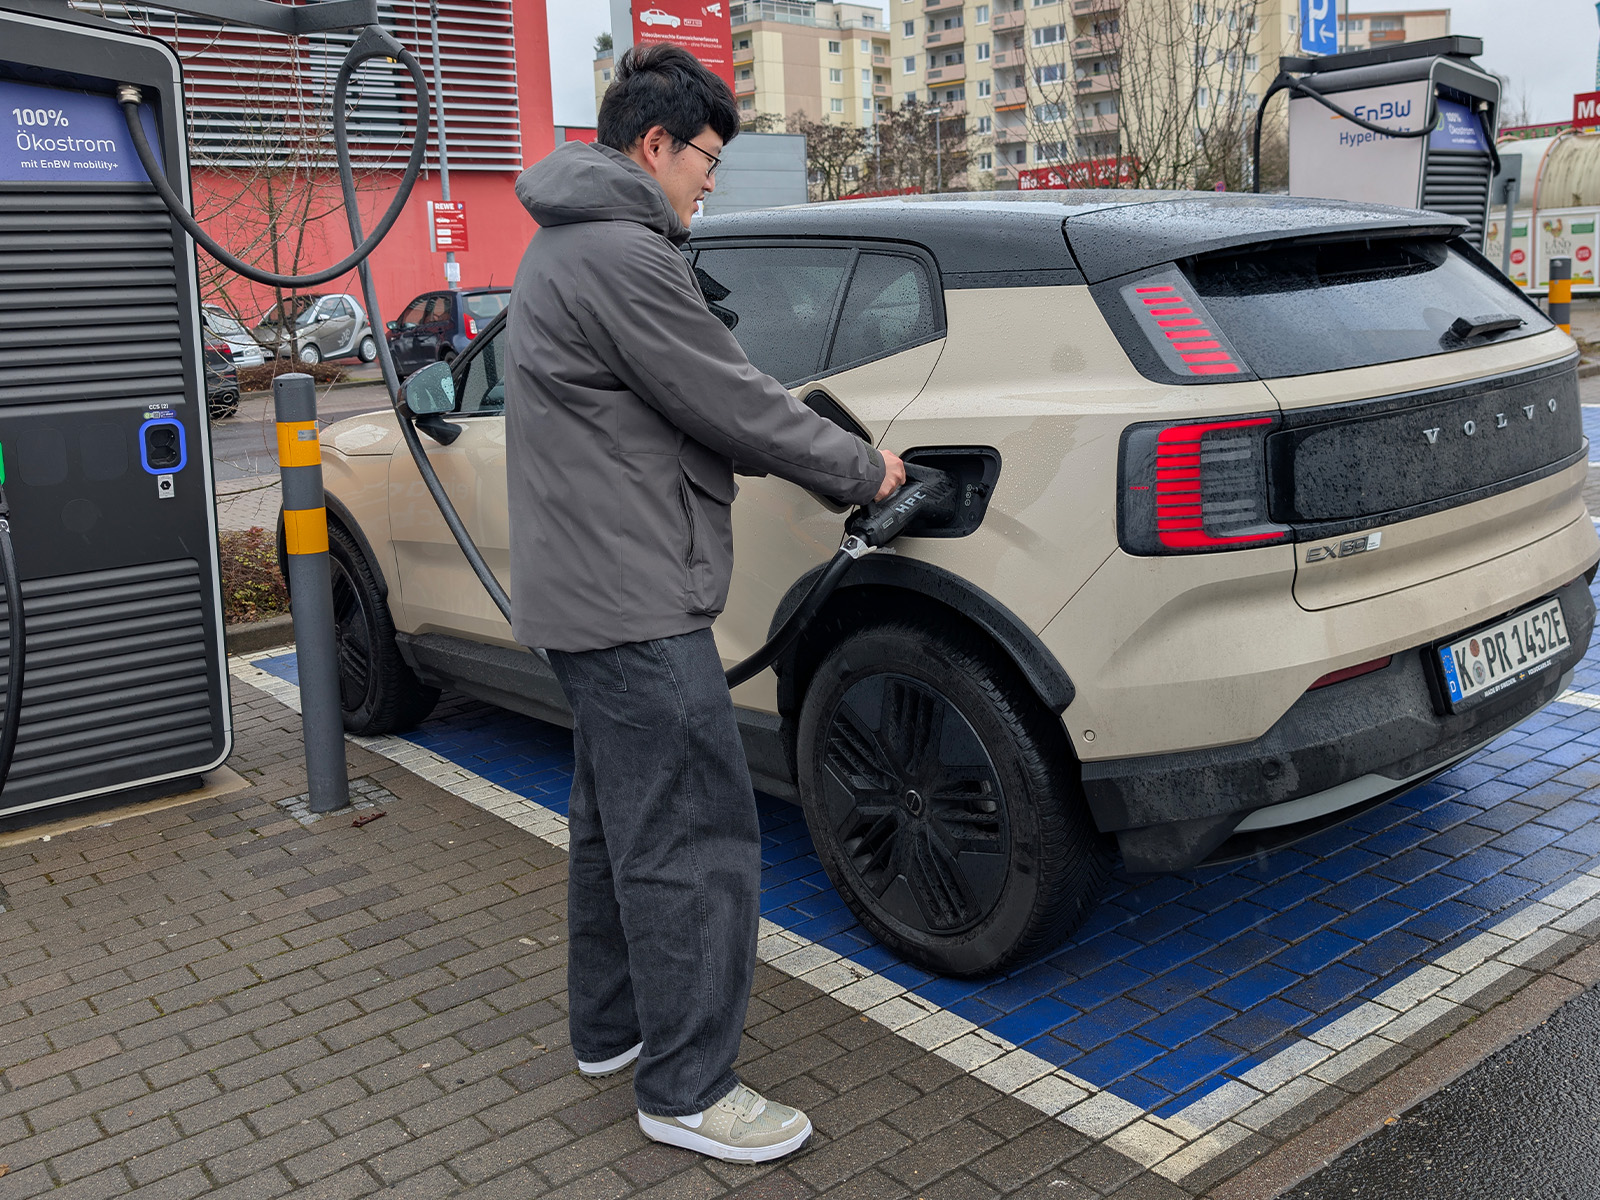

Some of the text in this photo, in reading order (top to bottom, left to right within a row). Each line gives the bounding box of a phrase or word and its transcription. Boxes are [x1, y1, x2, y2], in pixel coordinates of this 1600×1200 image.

[1308, 0, 1328, 42] P
[12, 108, 69, 127] 100%
[1354, 100, 1411, 121] EnBW
[16, 129, 116, 152] Ökostrom
[21, 159, 119, 171] mit EnBW mobility+
[1423, 398, 1557, 444] VOLVO
[895, 490, 926, 514] HPC
[1455, 606, 1567, 691] K PR 1452E
[1449, 681, 1456, 692] D
